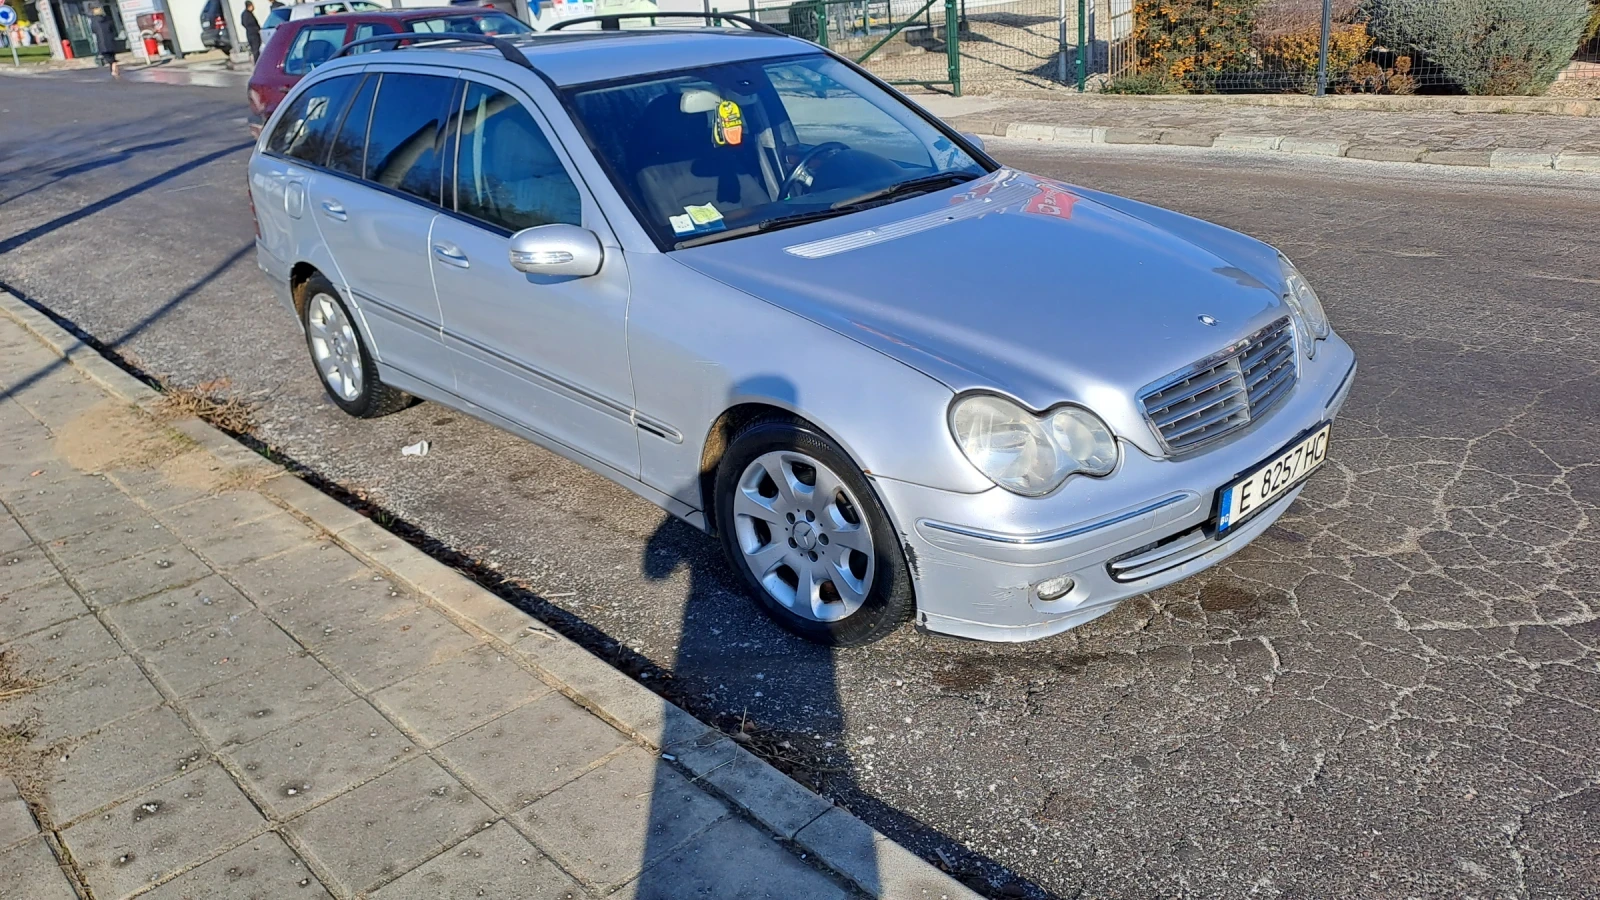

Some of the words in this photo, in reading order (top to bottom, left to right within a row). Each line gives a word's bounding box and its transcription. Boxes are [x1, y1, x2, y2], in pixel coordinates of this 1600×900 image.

[1240, 480, 1253, 513] E
[1261, 446, 1303, 499] 8257
[1304, 432, 1325, 469] HC
[1220, 513, 1230, 526] BG
